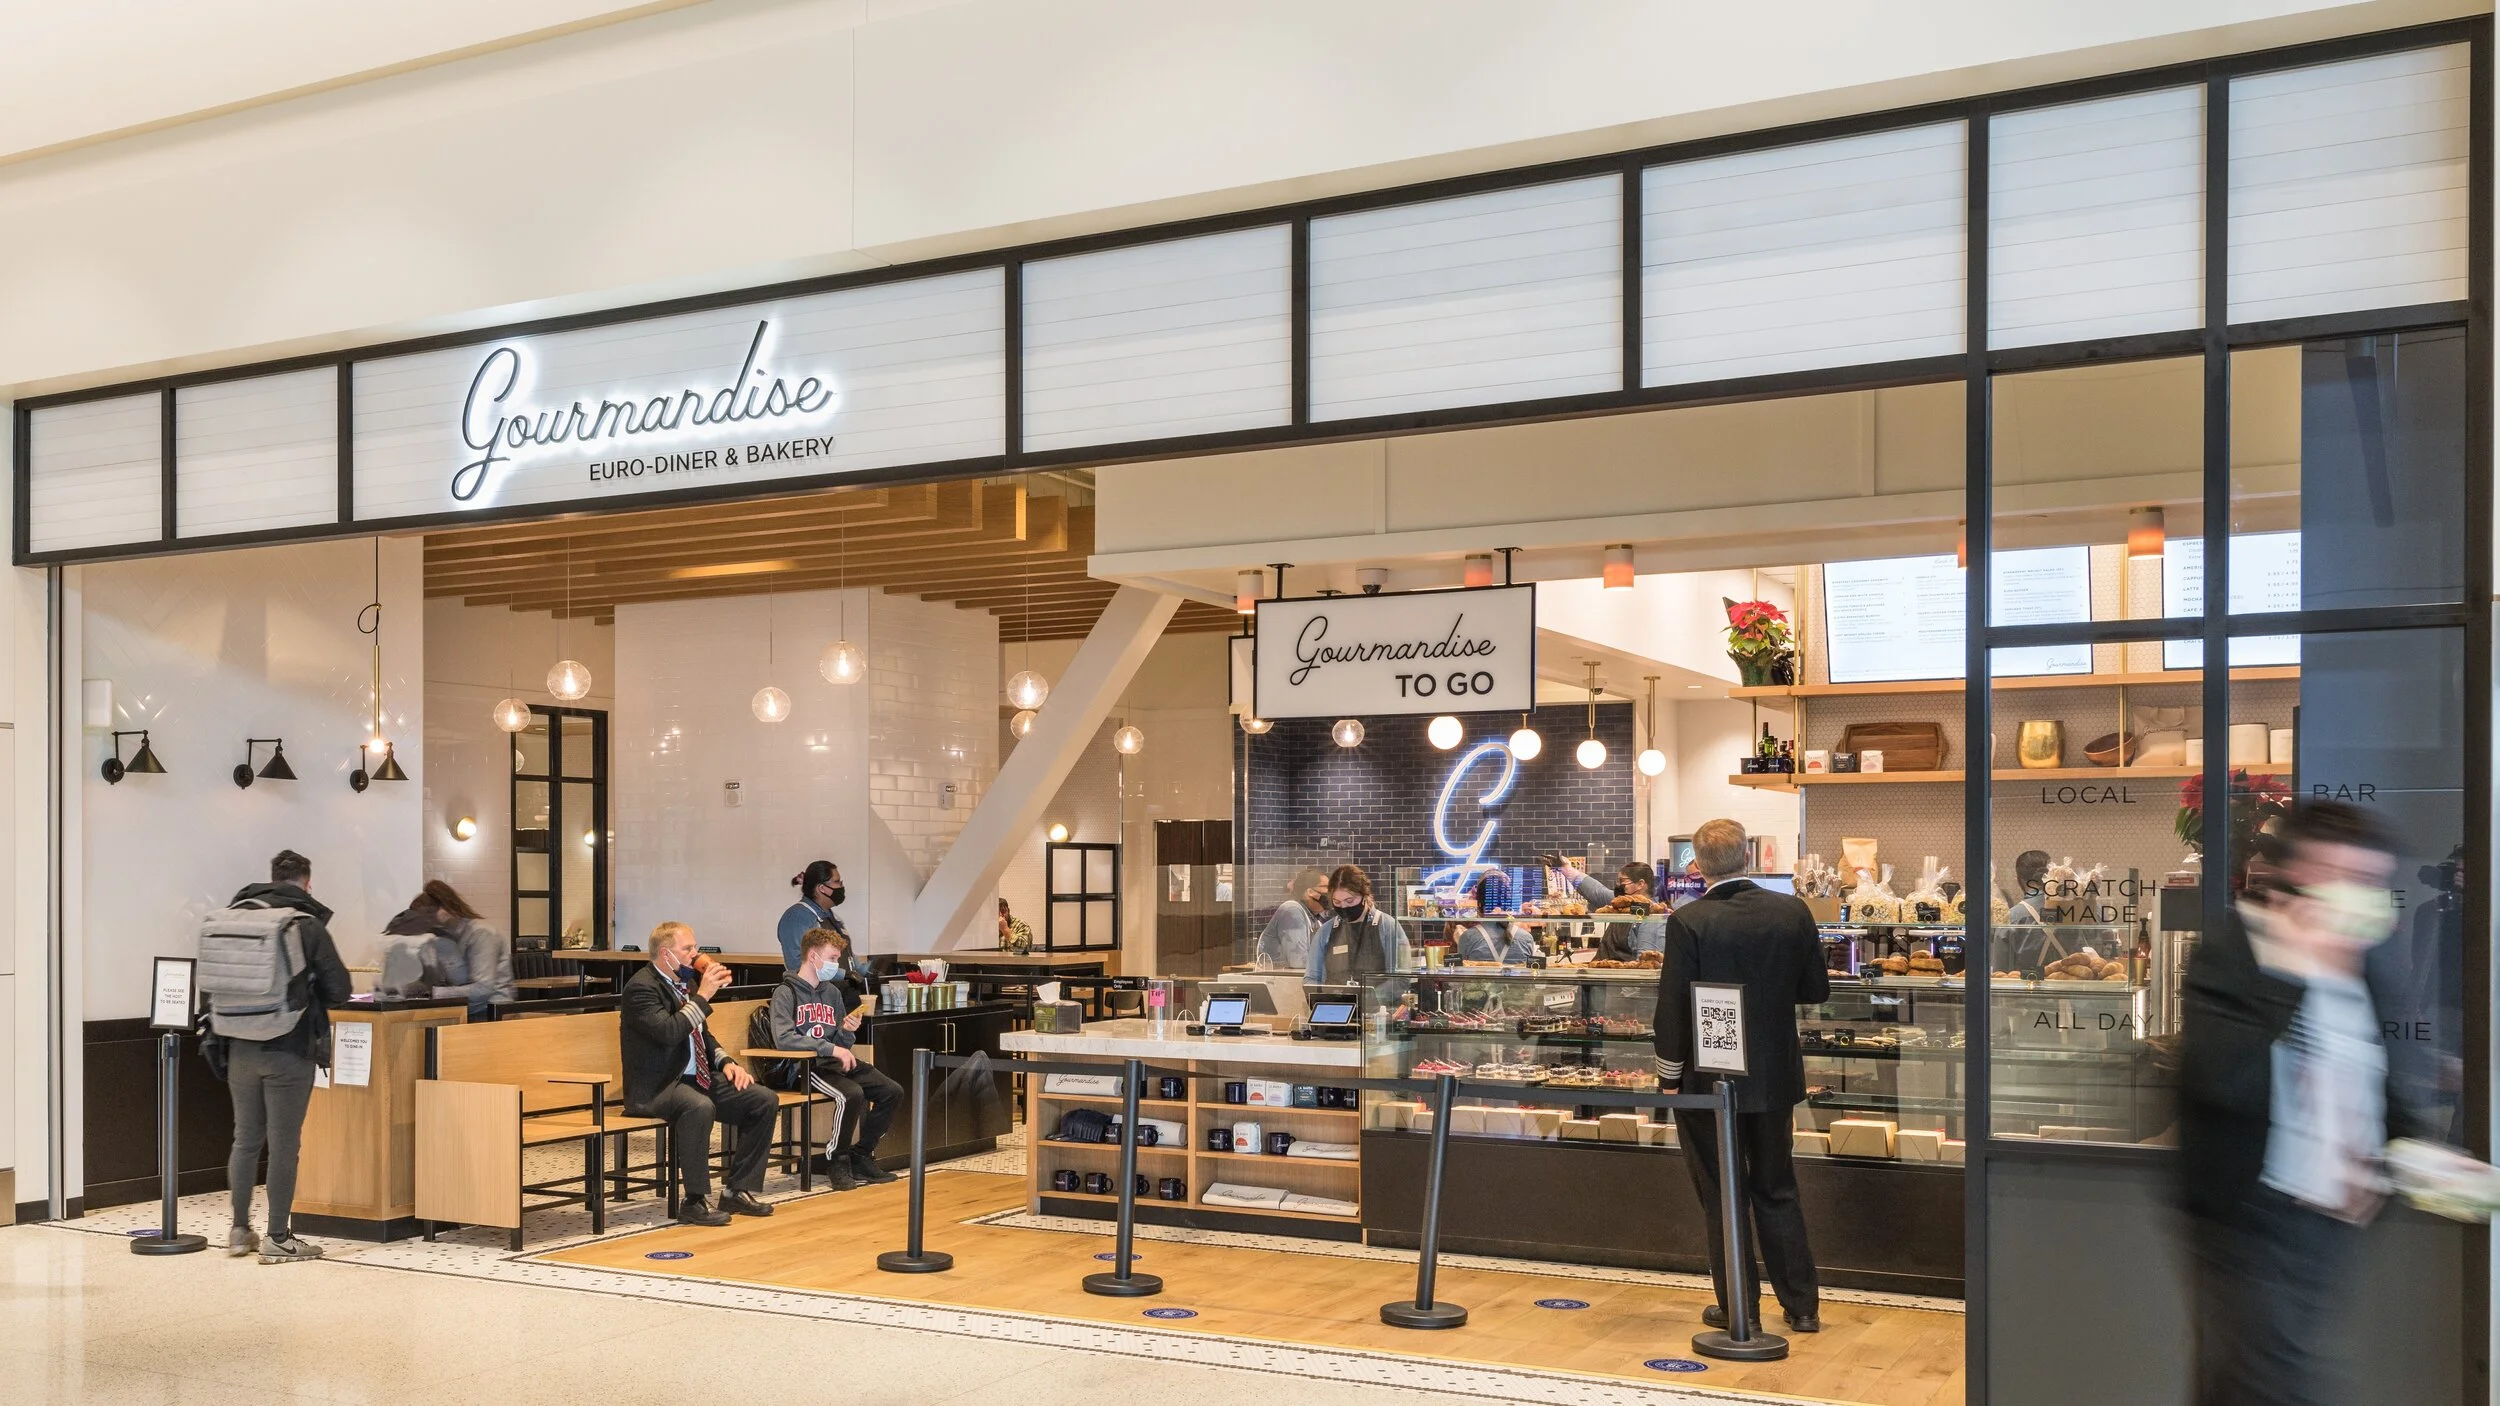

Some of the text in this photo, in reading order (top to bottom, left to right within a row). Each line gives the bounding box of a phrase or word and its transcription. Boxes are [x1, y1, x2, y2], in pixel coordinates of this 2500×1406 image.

[451, 320, 834, 502] Gourmandise
[589, 436, 835, 482] EURO-DINER & BAKERY
[1289, 612, 1497, 686] Gourmandise
[1395, 671, 1495, 698] TO GO
[2042, 786, 2137, 804] LOCAL
[2312, 783, 2376, 802] BAR
[2056, 905, 2138, 923] MADE
[796, 1002, 836, 1027] UTAH
[2033, 1011, 2154, 1032] ALL DAY
